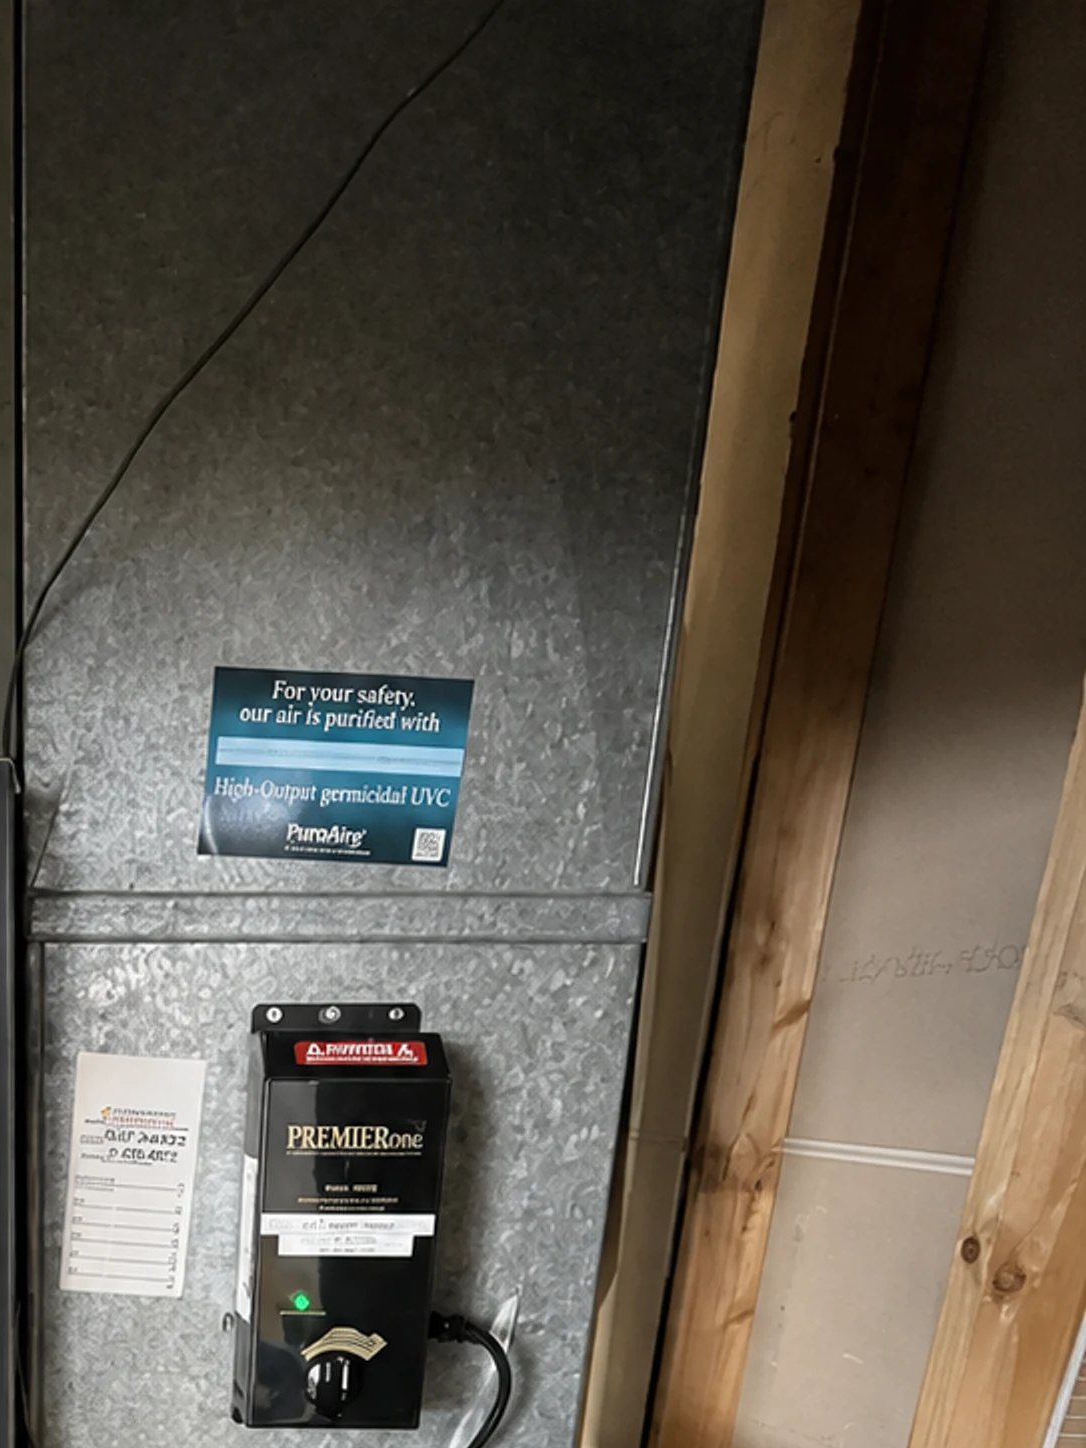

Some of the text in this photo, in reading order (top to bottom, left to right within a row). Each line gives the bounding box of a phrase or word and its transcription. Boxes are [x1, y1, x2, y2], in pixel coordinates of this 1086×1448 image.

[272, 679, 305, 701] For
[308, 686, 354, 707] your
[239, 704, 440, 733] our air is purified with
[320, 783, 407, 807] germicidal
[411, 786, 451, 807] UVC
